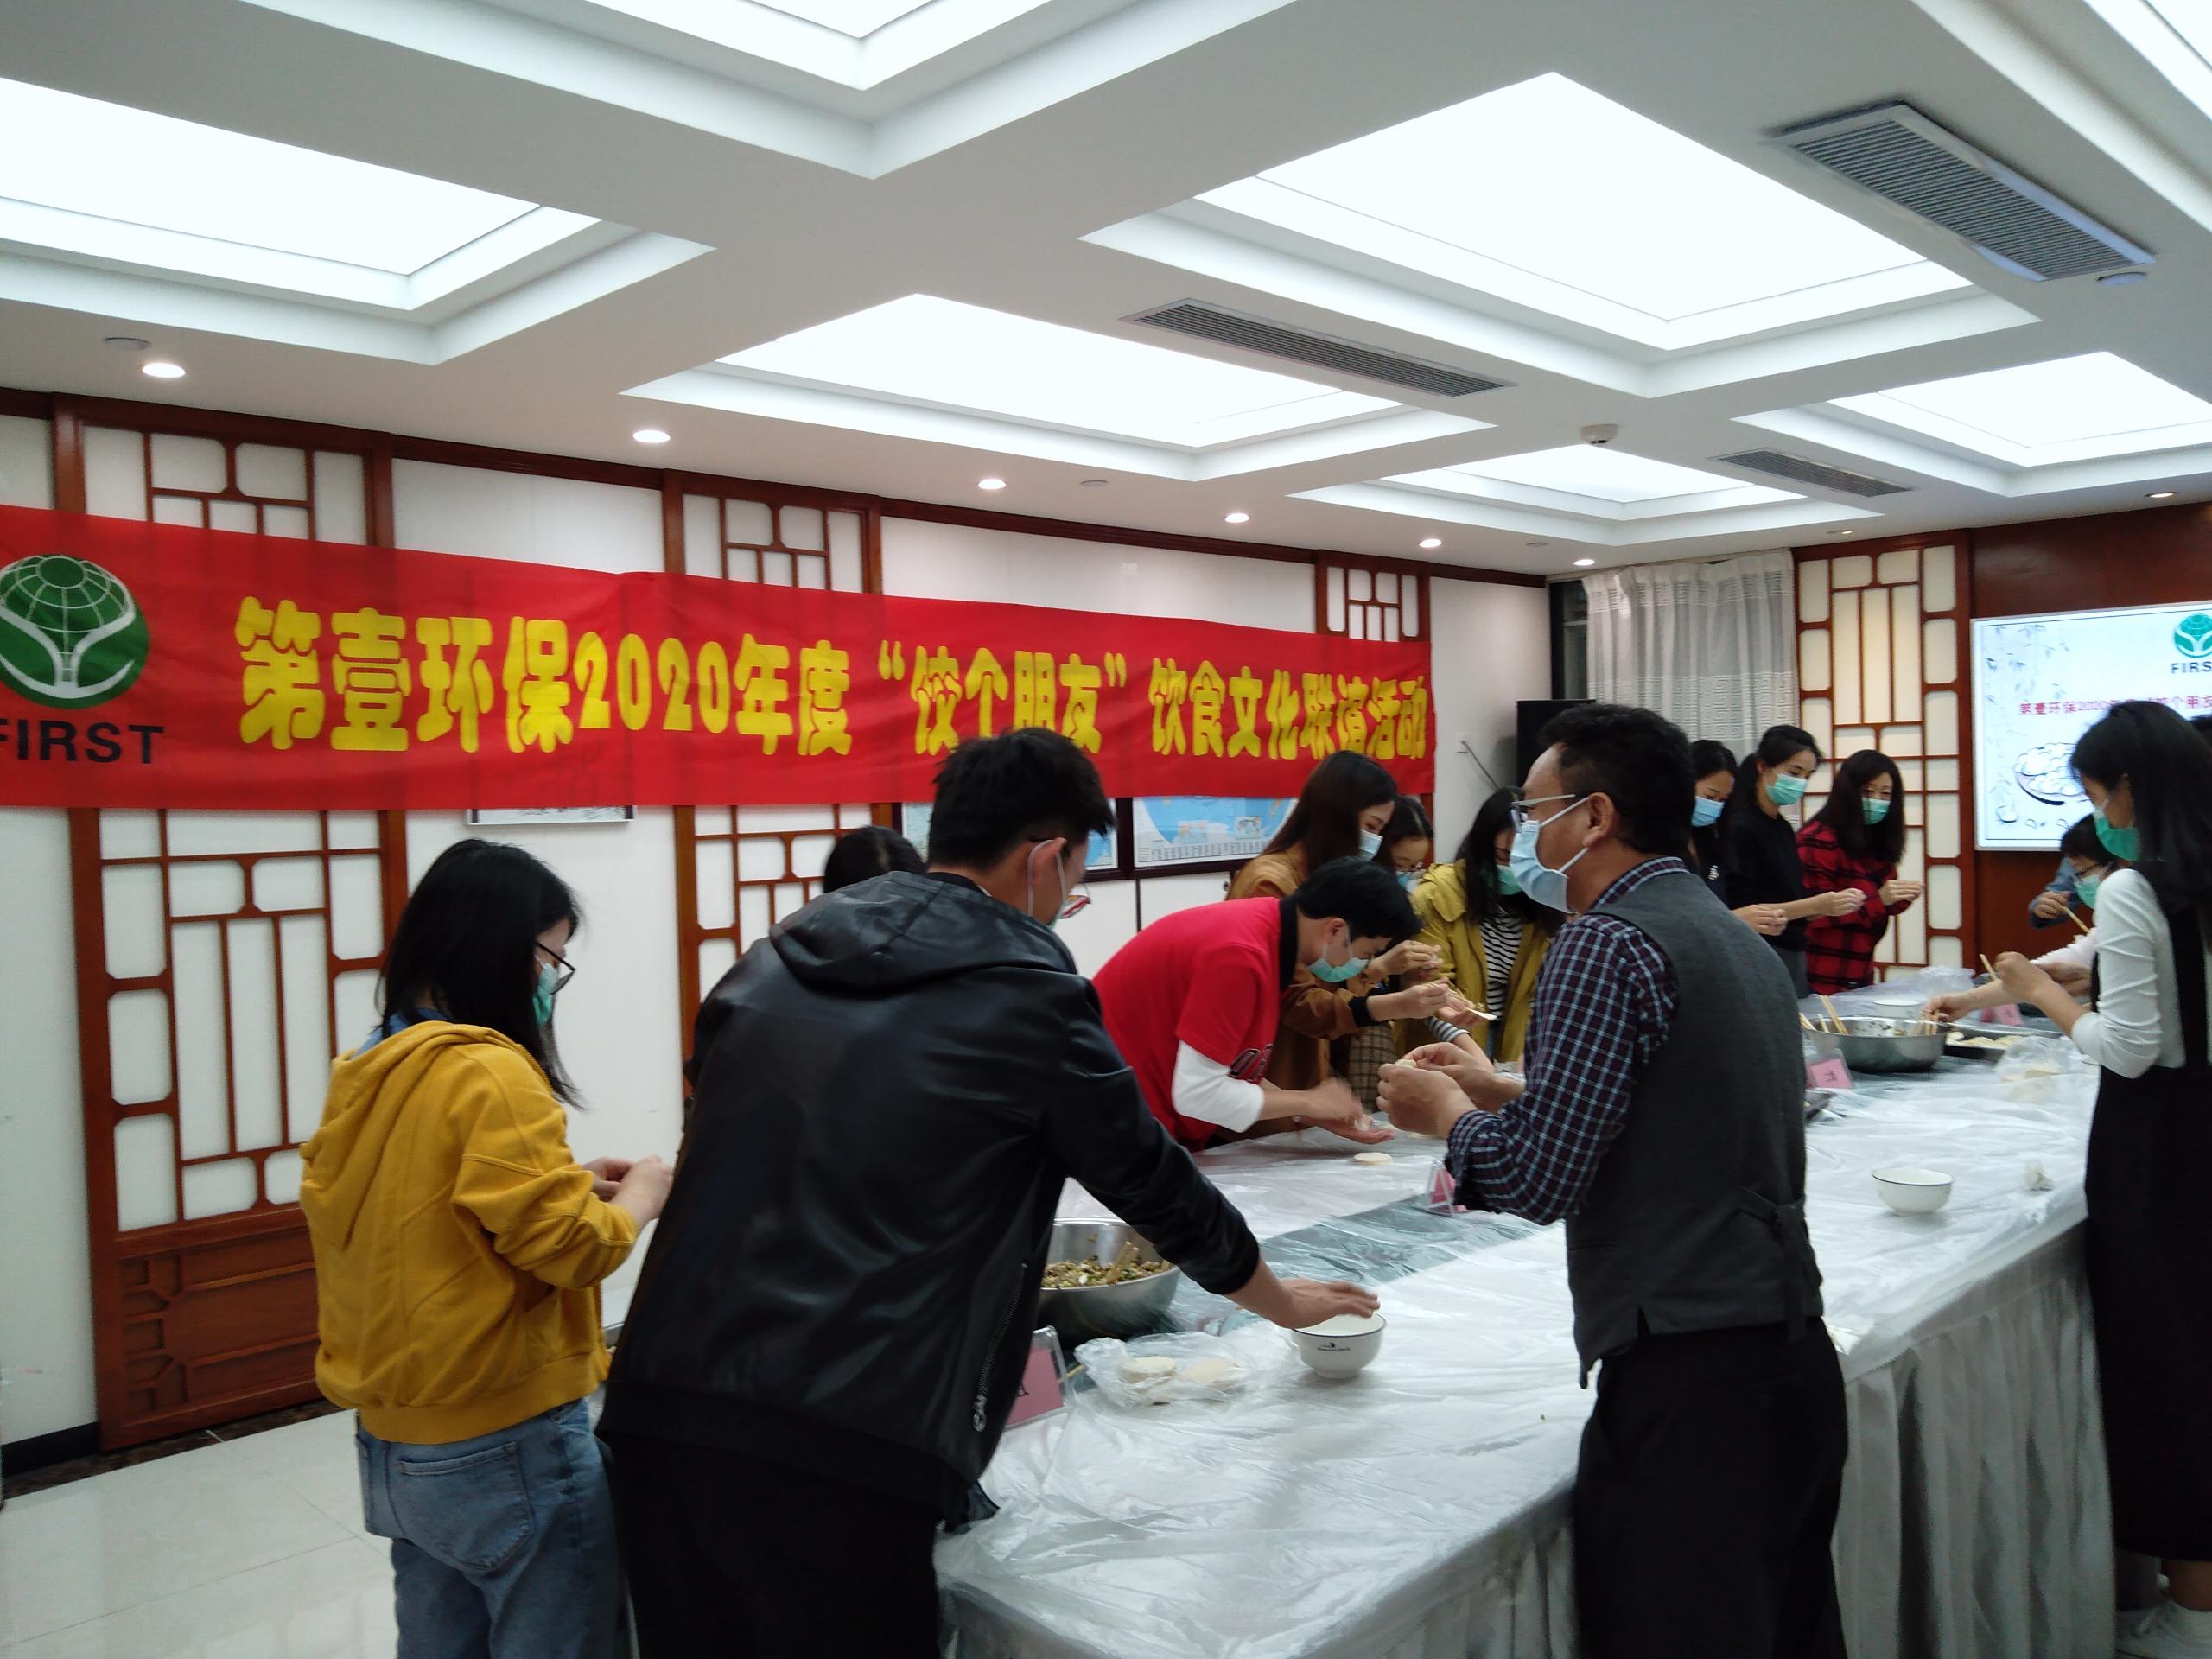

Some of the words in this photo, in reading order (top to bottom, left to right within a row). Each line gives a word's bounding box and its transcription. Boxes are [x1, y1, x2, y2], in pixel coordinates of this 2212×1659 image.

[234, 595, 852, 757] 第壹环保2020年度
